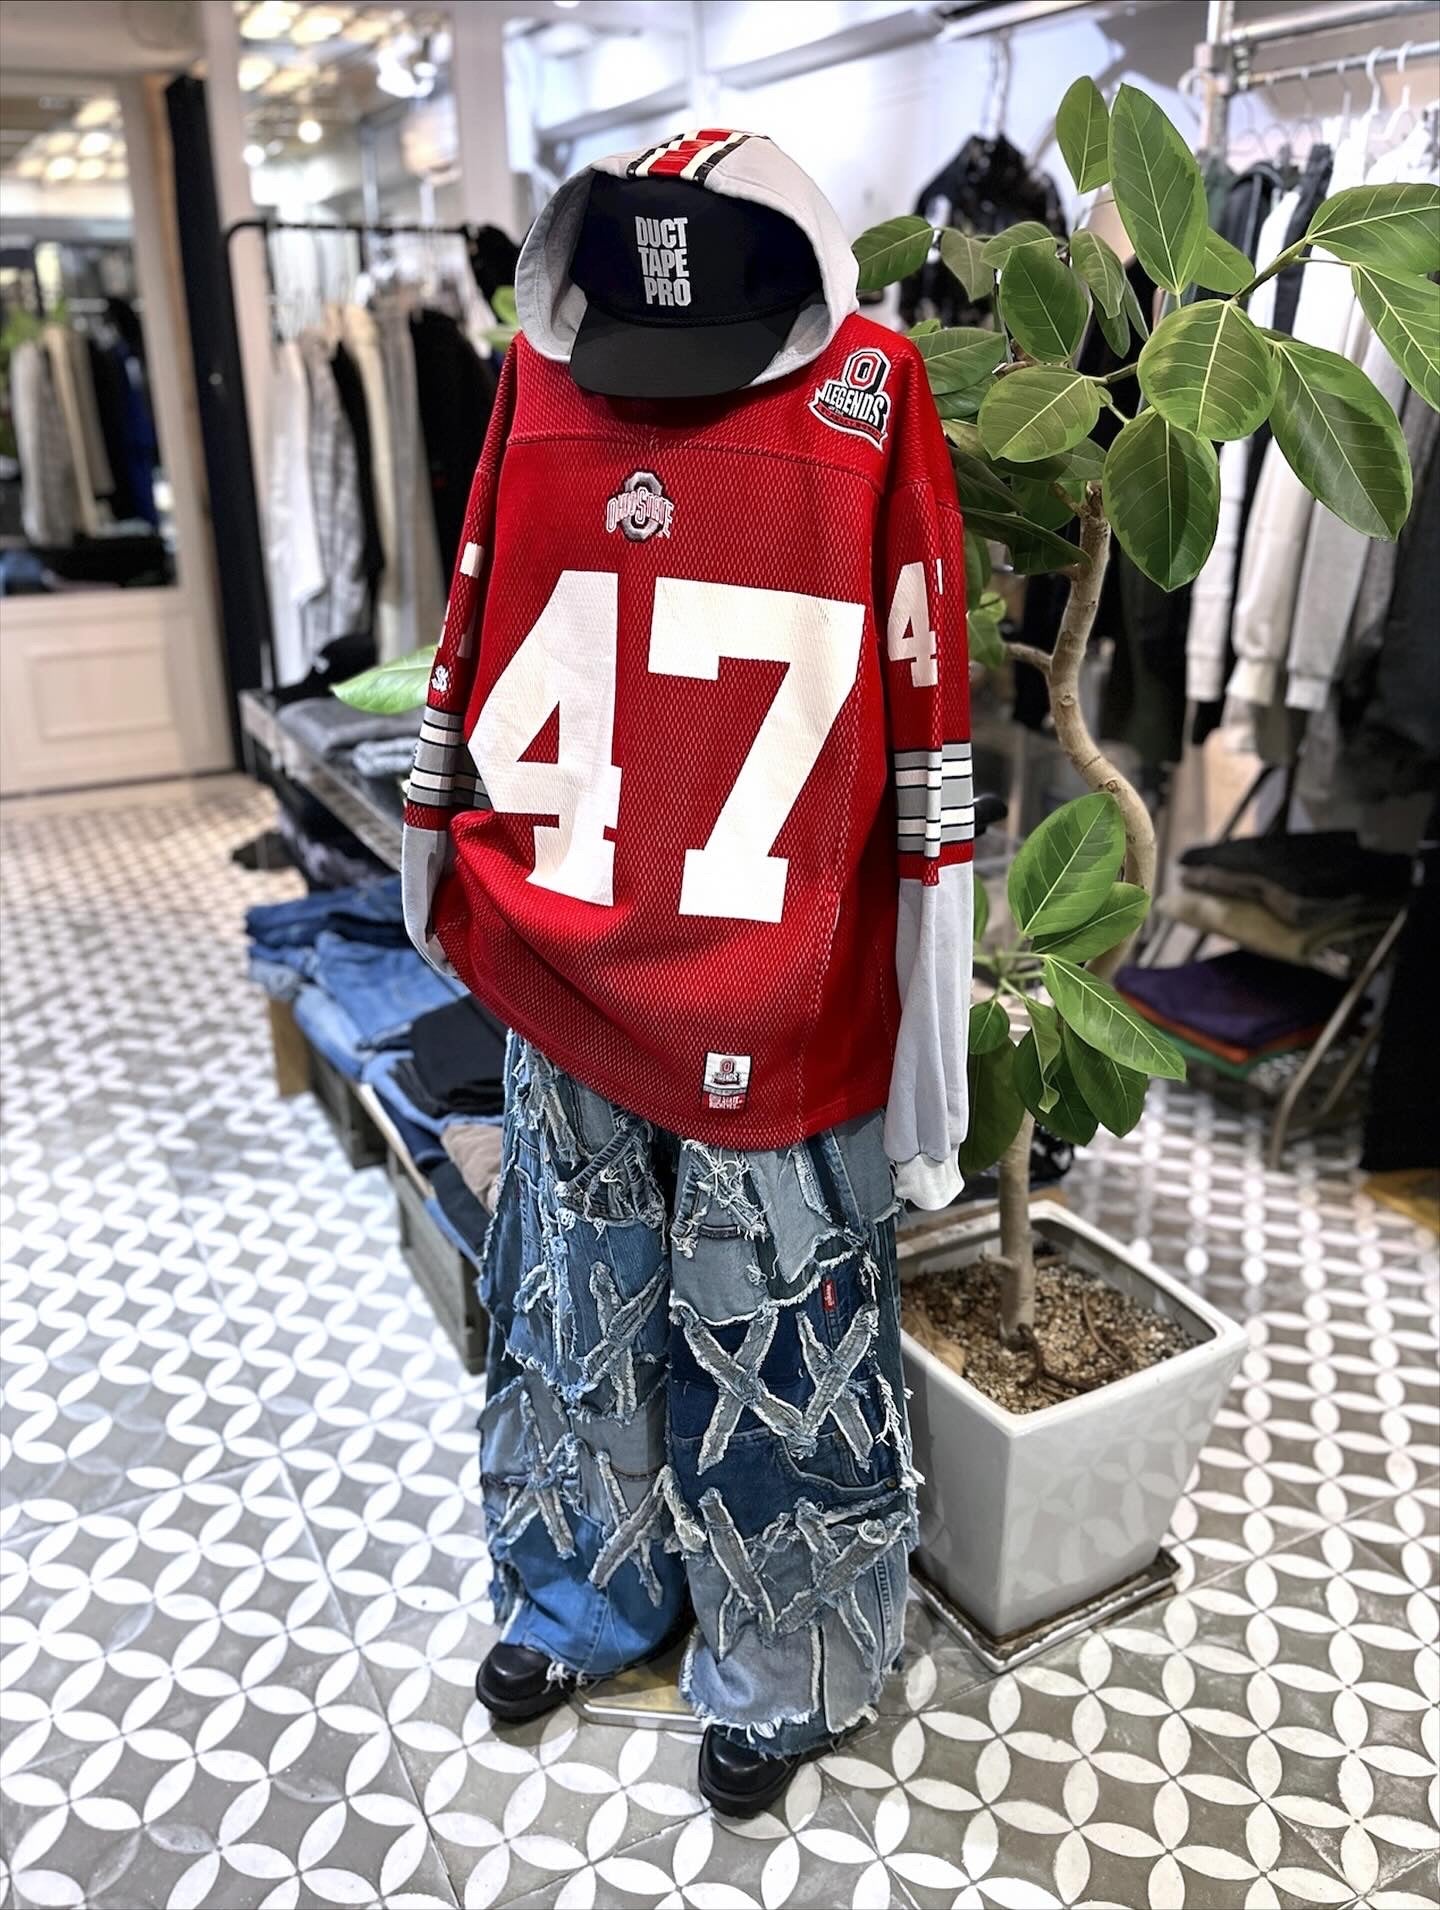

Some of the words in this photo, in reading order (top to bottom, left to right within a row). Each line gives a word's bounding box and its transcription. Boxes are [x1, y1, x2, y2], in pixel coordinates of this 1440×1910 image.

[635, 216, 688, 248] DUCT
[638, 246, 689, 278] TAPE
[644, 276, 691, 306] PRO
[824, 383, 885, 427] LEGENDS
[467, 569, 866, 923] 47
